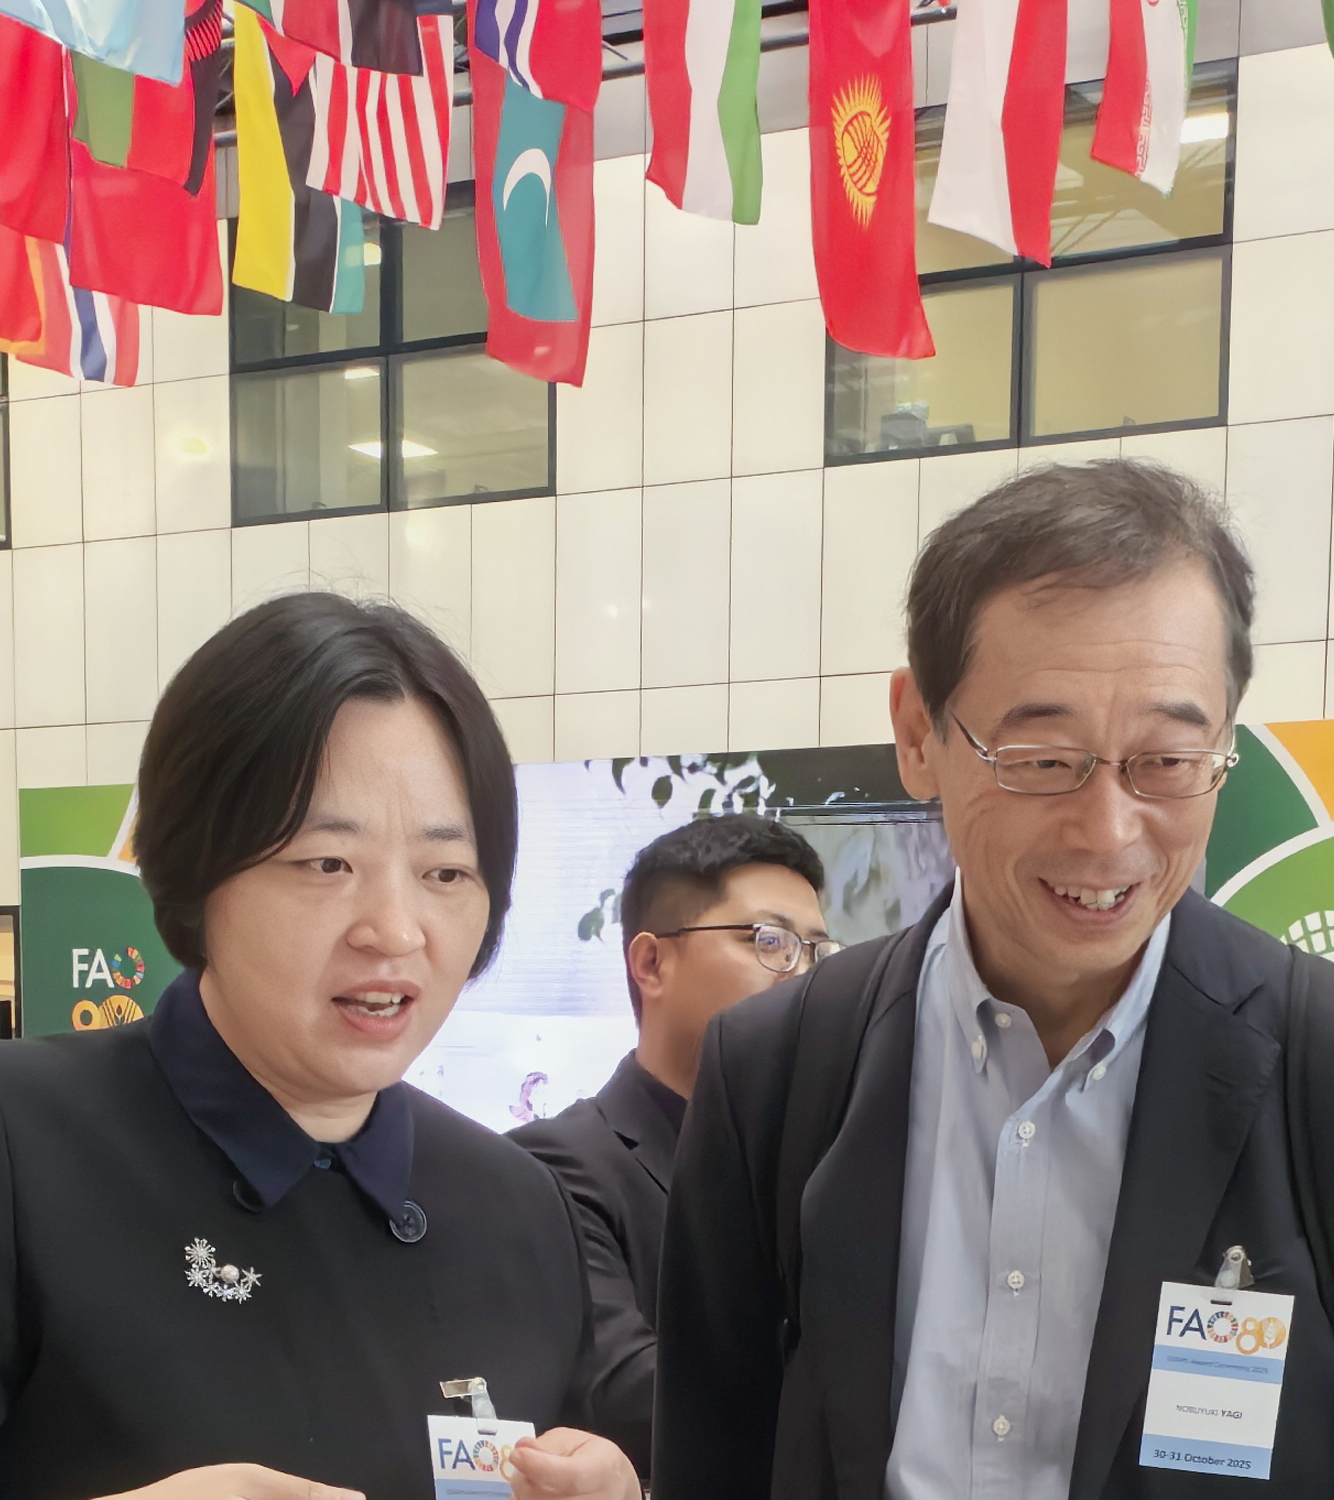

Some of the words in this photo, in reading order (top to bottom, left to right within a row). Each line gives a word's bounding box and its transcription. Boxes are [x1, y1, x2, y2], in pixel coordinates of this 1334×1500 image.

[72, 945, 145, 989] FAO
[1166, 1305, 1239, 1344] FAO
[1153, 1448, 1181, 1462] 30-31
[1184, 1453, 1226, 1467] October
[1227, 1457, 1252, 1470] 2025
